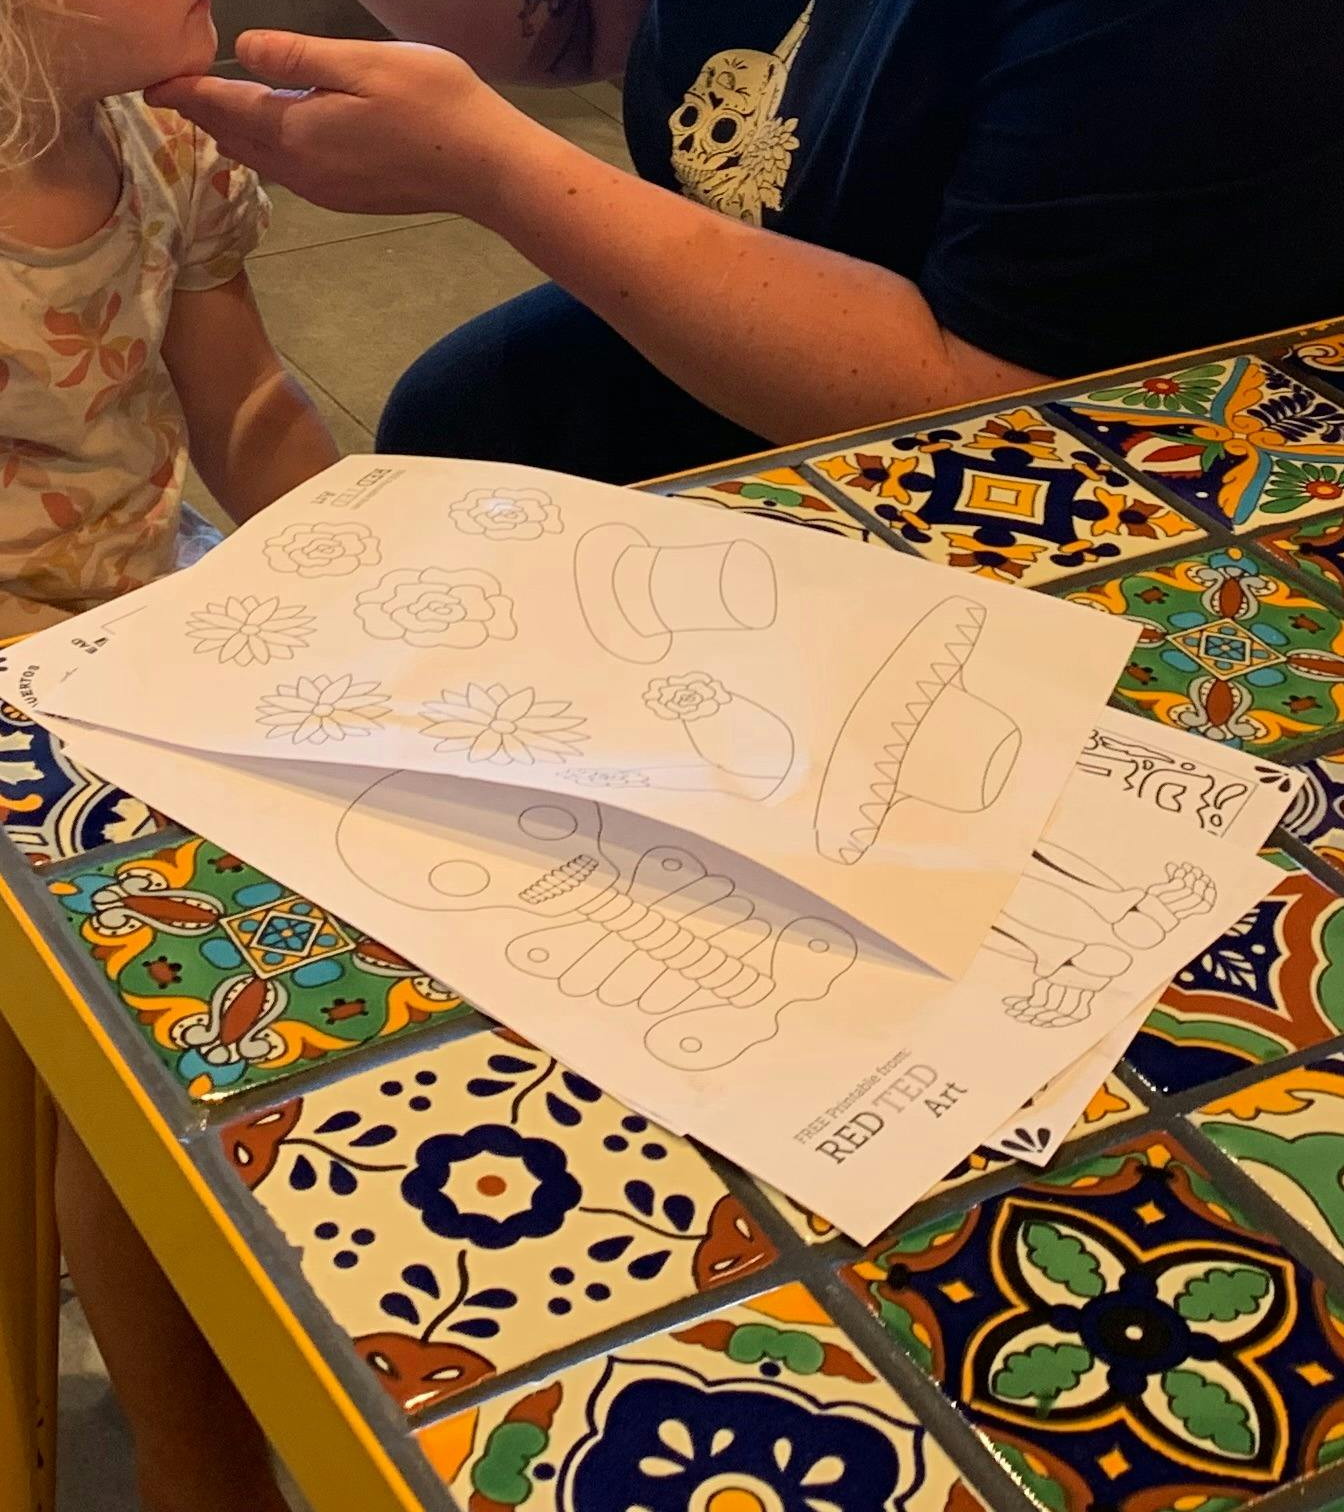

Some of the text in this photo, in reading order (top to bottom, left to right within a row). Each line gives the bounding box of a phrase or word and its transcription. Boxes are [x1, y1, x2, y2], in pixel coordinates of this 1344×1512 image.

[793, 1111, 831, 1145] FREE
[826, 1072, 881, 1120] Printable
[814, 1063, 939, 1165] RED TED
[923, 1081, 969, 1119] Art
